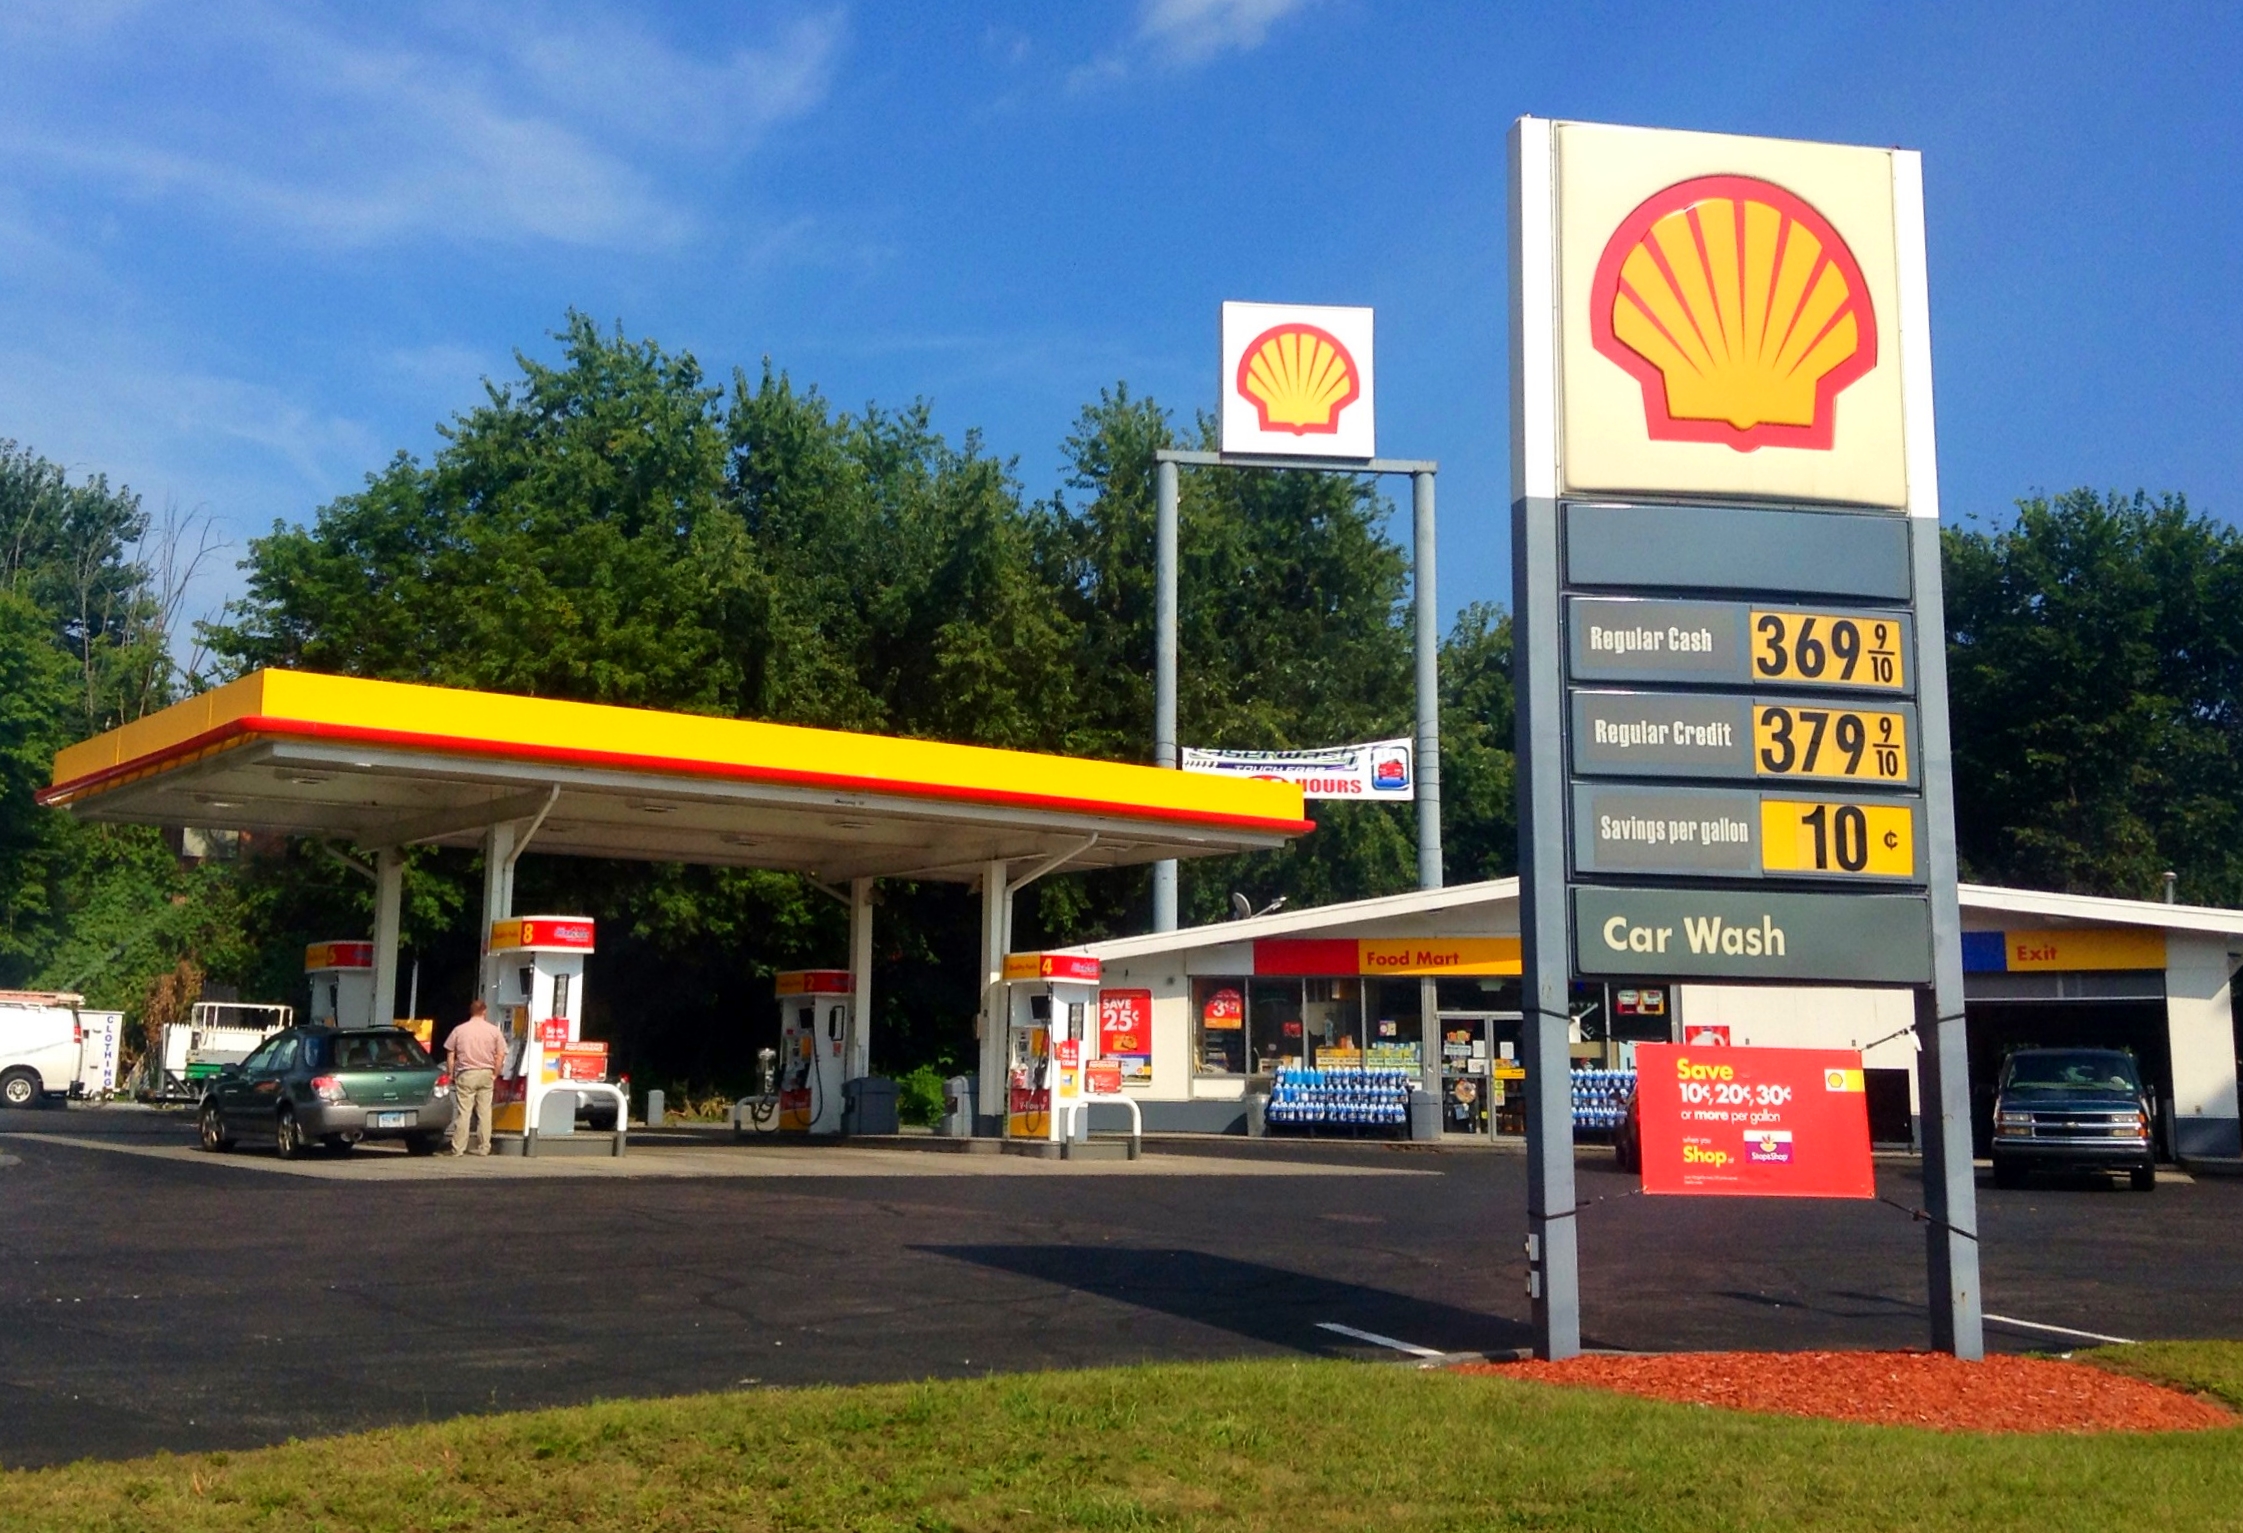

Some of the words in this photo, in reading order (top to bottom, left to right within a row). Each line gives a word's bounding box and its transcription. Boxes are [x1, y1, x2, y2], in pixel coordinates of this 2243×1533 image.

[1590, 626, 1664, 654] Regular
[1668, 627, 1712, 652] Cash
[1757, 615, 1860, 681] 369
[1594, 719, 1669, 748] Regular
[1673, 721, 1732, 747] Credit
[1761, 707, 1866, 775] 379
[1601, 815, 1666, 844] Savings
[1669, 821, 1698, 844] per
[1701, 817, 1749, 845] gallon
[1802, 804, 1867, 872] 10
[523, 923, 534, 944] 8
[1603, 916, 1673, 953] Car
[1683, 915, 1785, 957] Wash
[1367, 950, 1410, 966] Food
[1416, 951, 1459, 966] Mart
[2018, 945, 2057, 961] Exit
[1042, 958, 1053, 975] 4
[807, 976, 815, 990] 2
[1102, 999, 1132, 1010] SAVE
[105, 1015, 114, 1087] CLOTHING
[1677, 1058, 1734, 1080] Save
[1681, 1111, 1692, 1120] or
[1694, 1111, 1729, 1120] more
[1731, 1112, 1748, 1125] per
[1750, 1108, 1780, 1125] gallon
[1683, 1145, 1727, 1168] Shop
